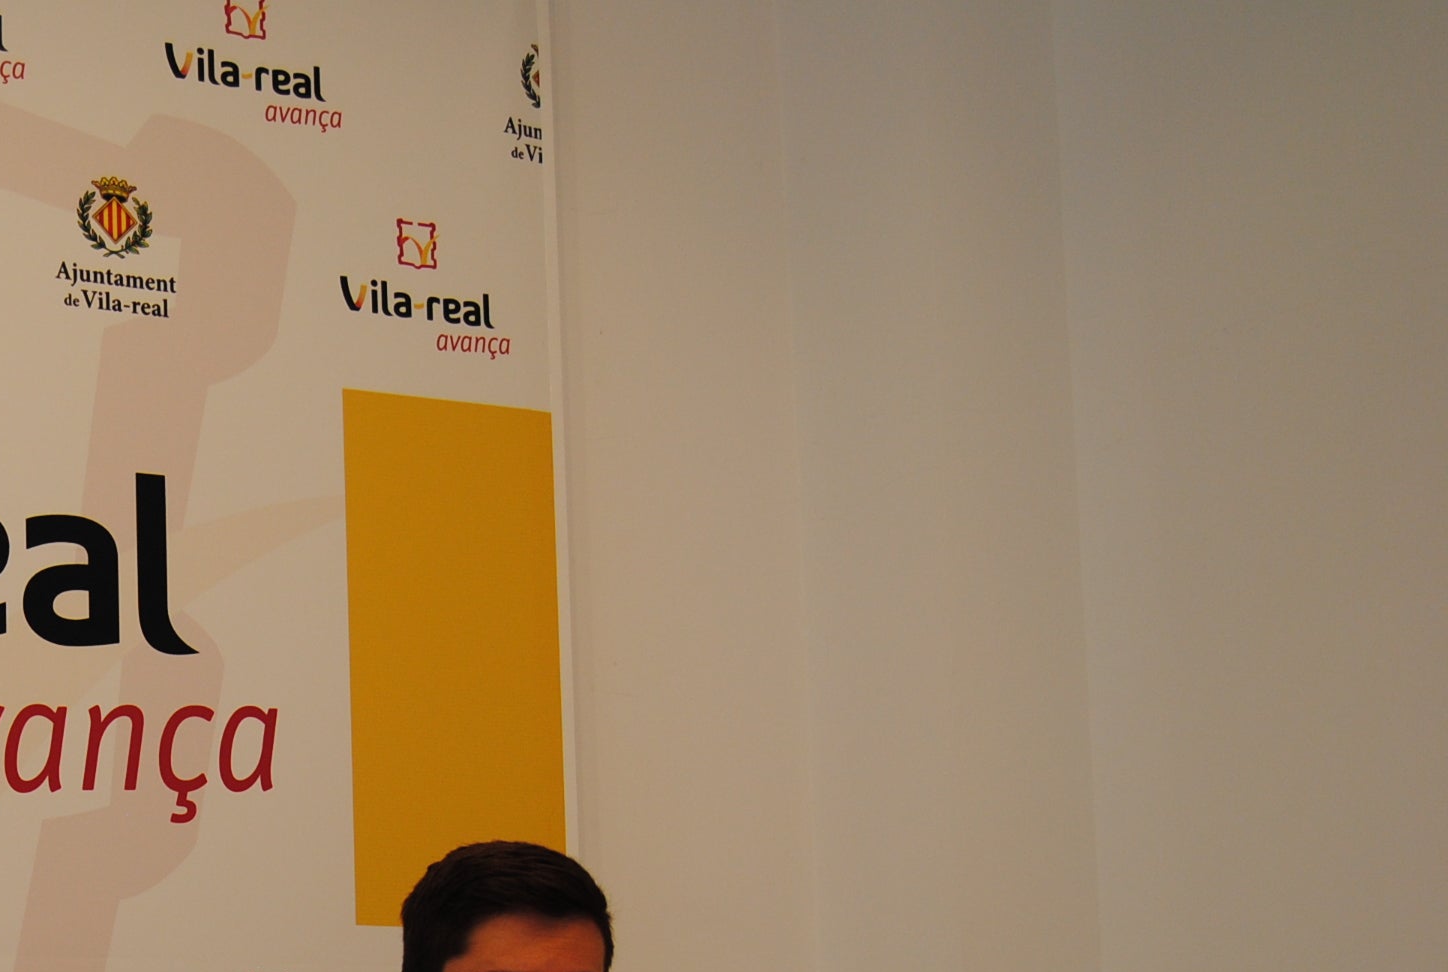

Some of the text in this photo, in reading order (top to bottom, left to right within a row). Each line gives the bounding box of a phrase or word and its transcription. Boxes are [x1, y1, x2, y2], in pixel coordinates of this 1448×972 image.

[164, 42, 326, 102] Vila-real
[264, 102, 342, 133] avança
[511, 147, 524, 159] de
[55, 261, 177, 294] Ajuntament
[64, 290, 169, 318] de Vila-real
[340, 276, 494, 329] Vila-real
[436, 331, 511, 360] avança
